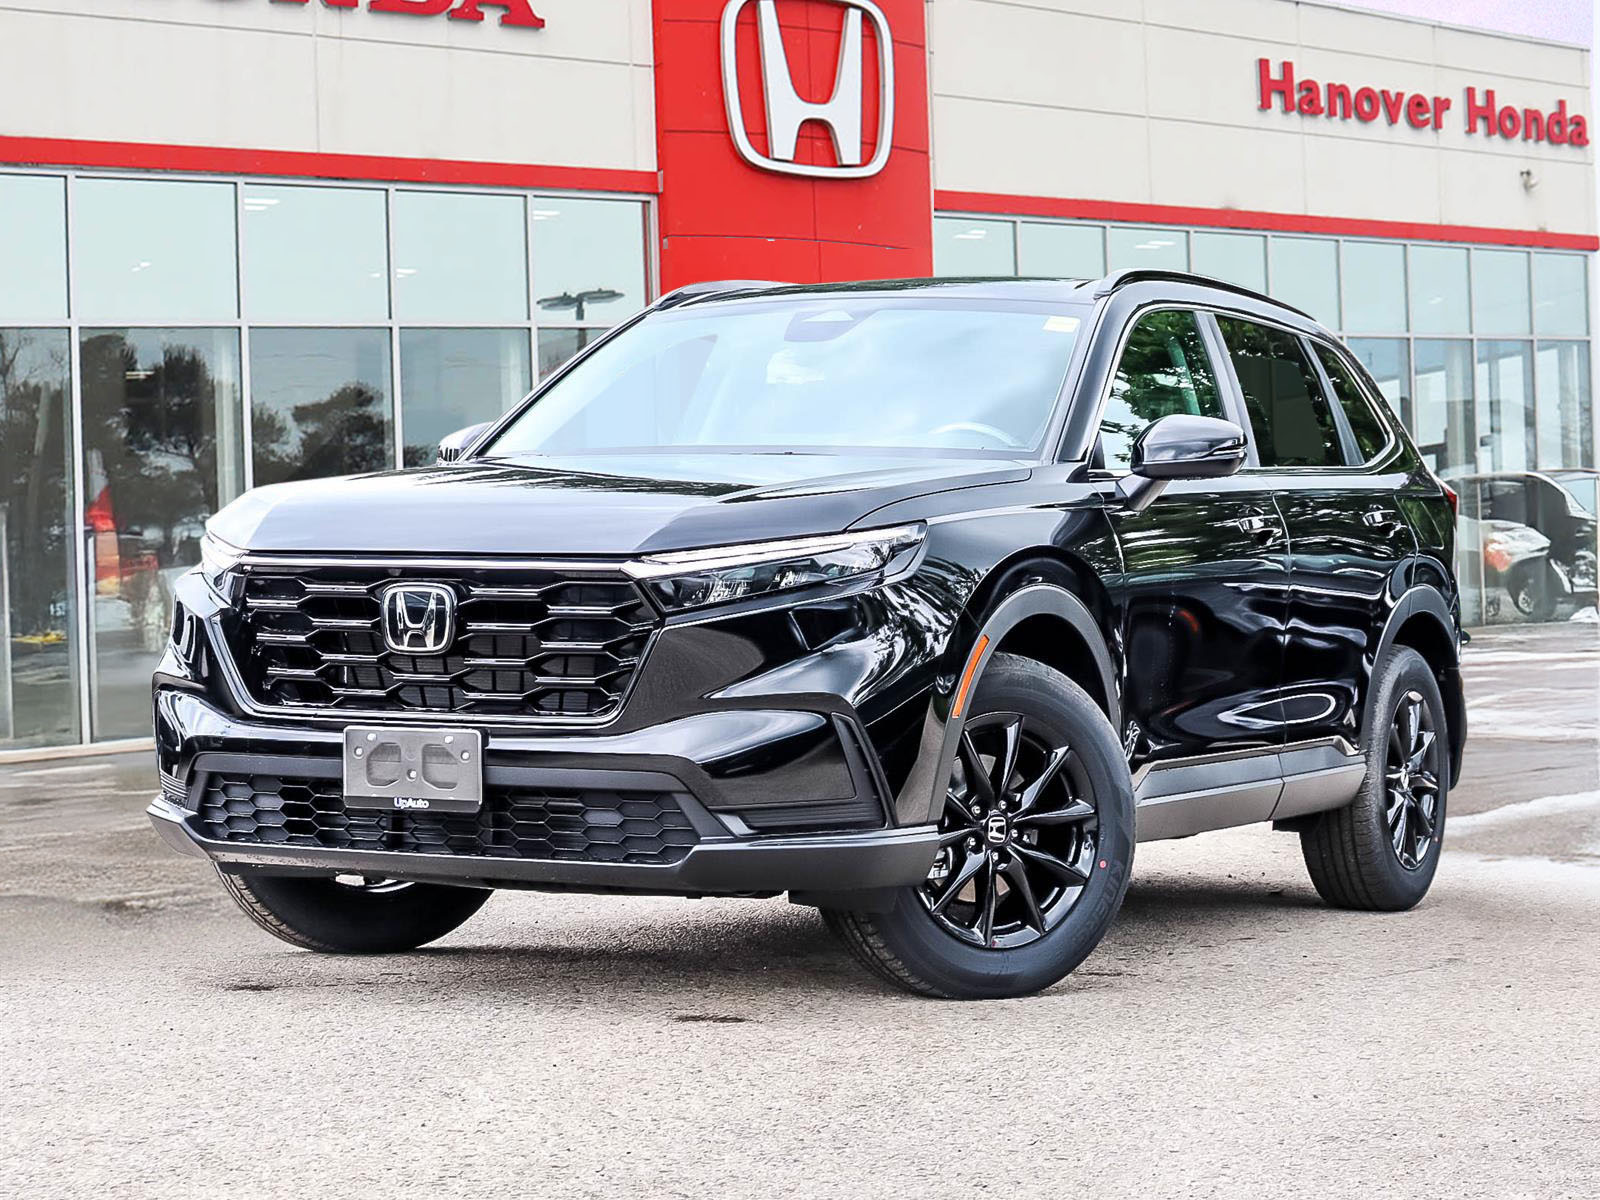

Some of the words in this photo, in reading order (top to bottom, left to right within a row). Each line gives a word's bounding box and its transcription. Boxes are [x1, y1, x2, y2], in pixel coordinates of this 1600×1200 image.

[1257, 58, 1452, 130] Hanover
[1465, 86, 1590, 147] Honda
[393, 797, 430, 809] UpAuto
